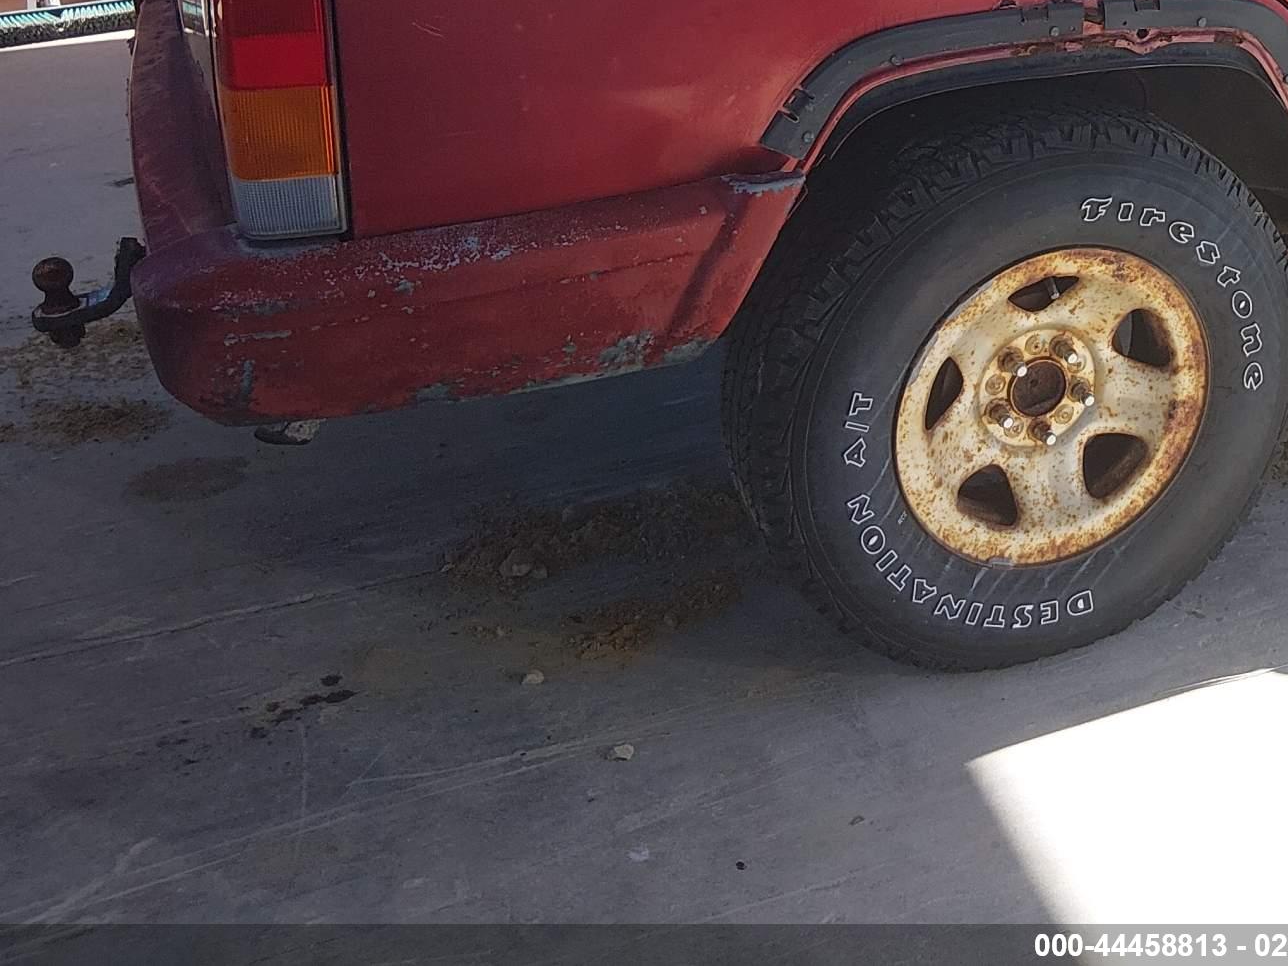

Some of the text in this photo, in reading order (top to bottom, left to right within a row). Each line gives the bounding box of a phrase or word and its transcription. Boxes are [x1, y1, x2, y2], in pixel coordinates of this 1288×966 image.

[1081, 197, 1263, 390] Firestone
[843, 392, 1093, 628] DESTINATION A/T
